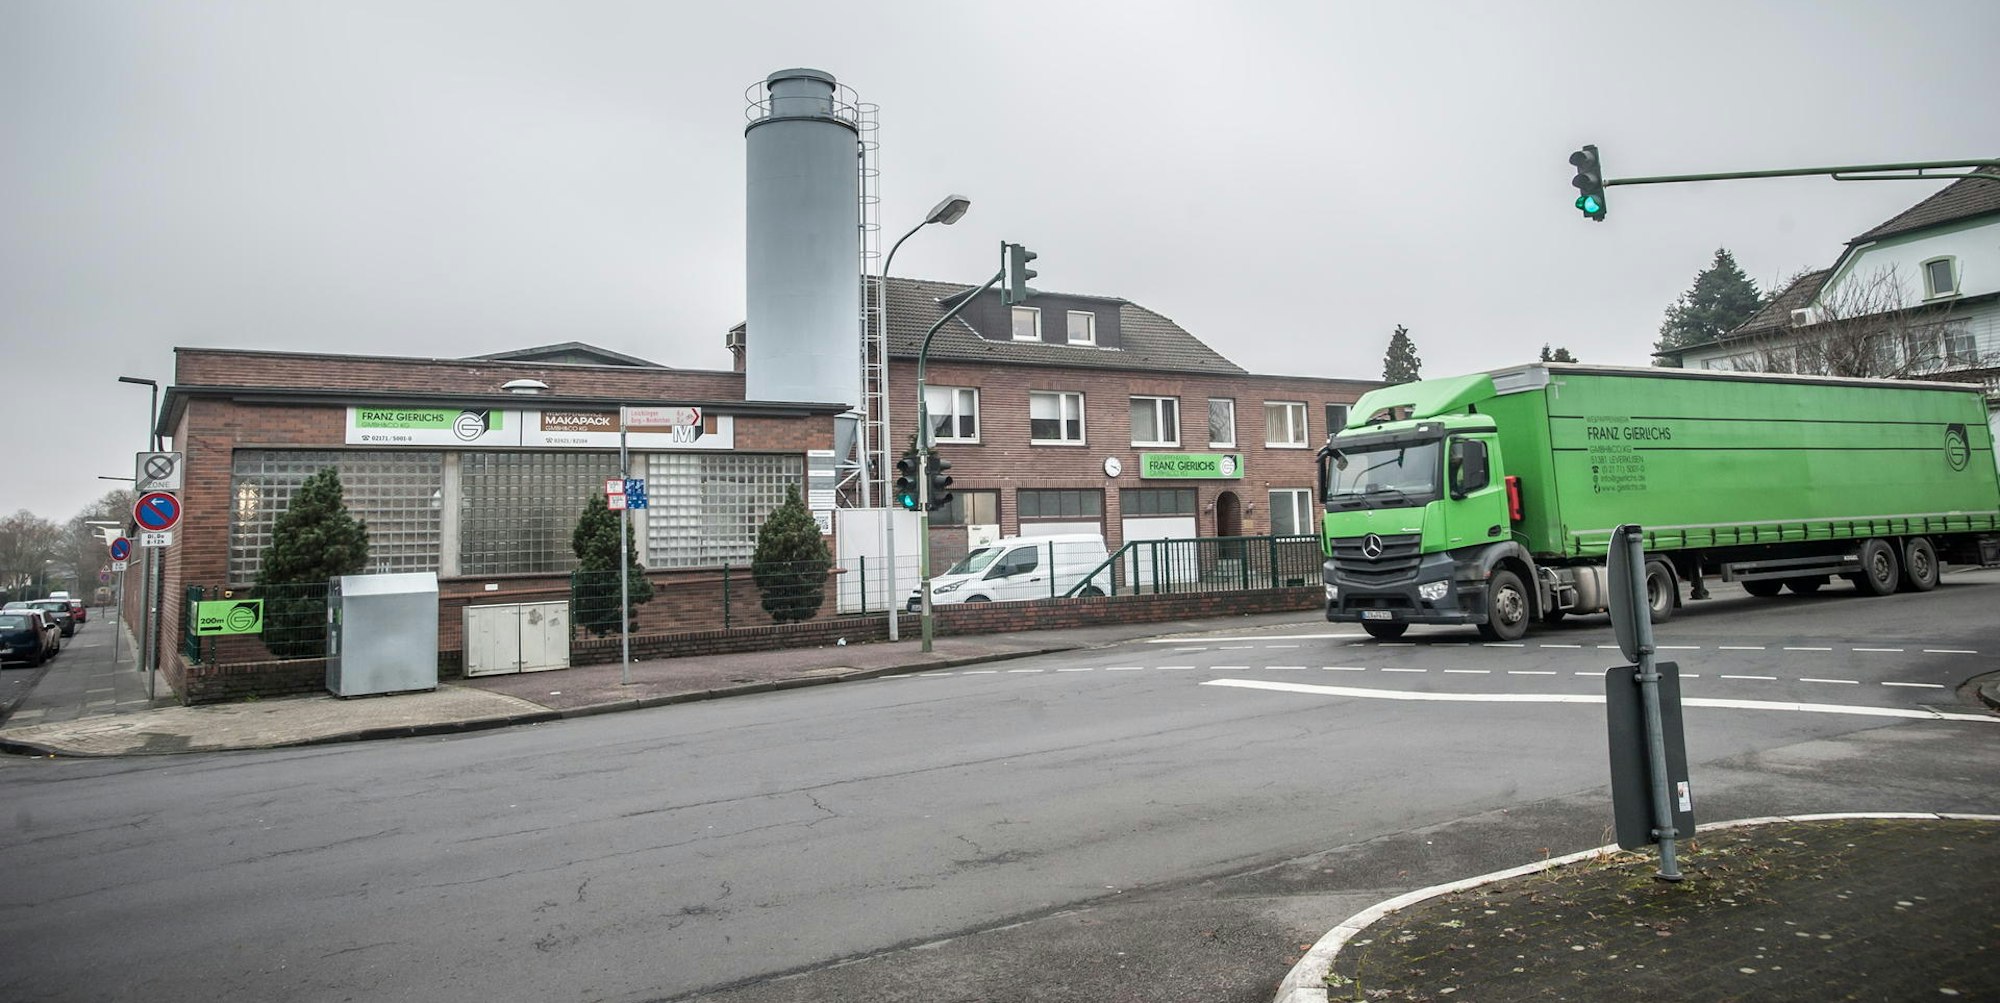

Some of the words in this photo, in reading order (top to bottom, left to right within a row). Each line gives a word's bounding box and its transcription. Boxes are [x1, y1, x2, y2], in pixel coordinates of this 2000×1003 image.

[361, 411, 394, 422] FRANZ
[396, 412, 444, 423] GIERLICHS
[545, 416, 611, 426] MAKAPACK
[1587, 426, 1620, 440] FRANZ
[1623, 426, 1672, 440] GIERLICHS
[1149, 461, 1175, 471] FRANZ
[1177, 461, 1215, 471] GIERLICHS
[147, 481, 169, 489] ZONE
[200, 617, 225, 625] 200m
